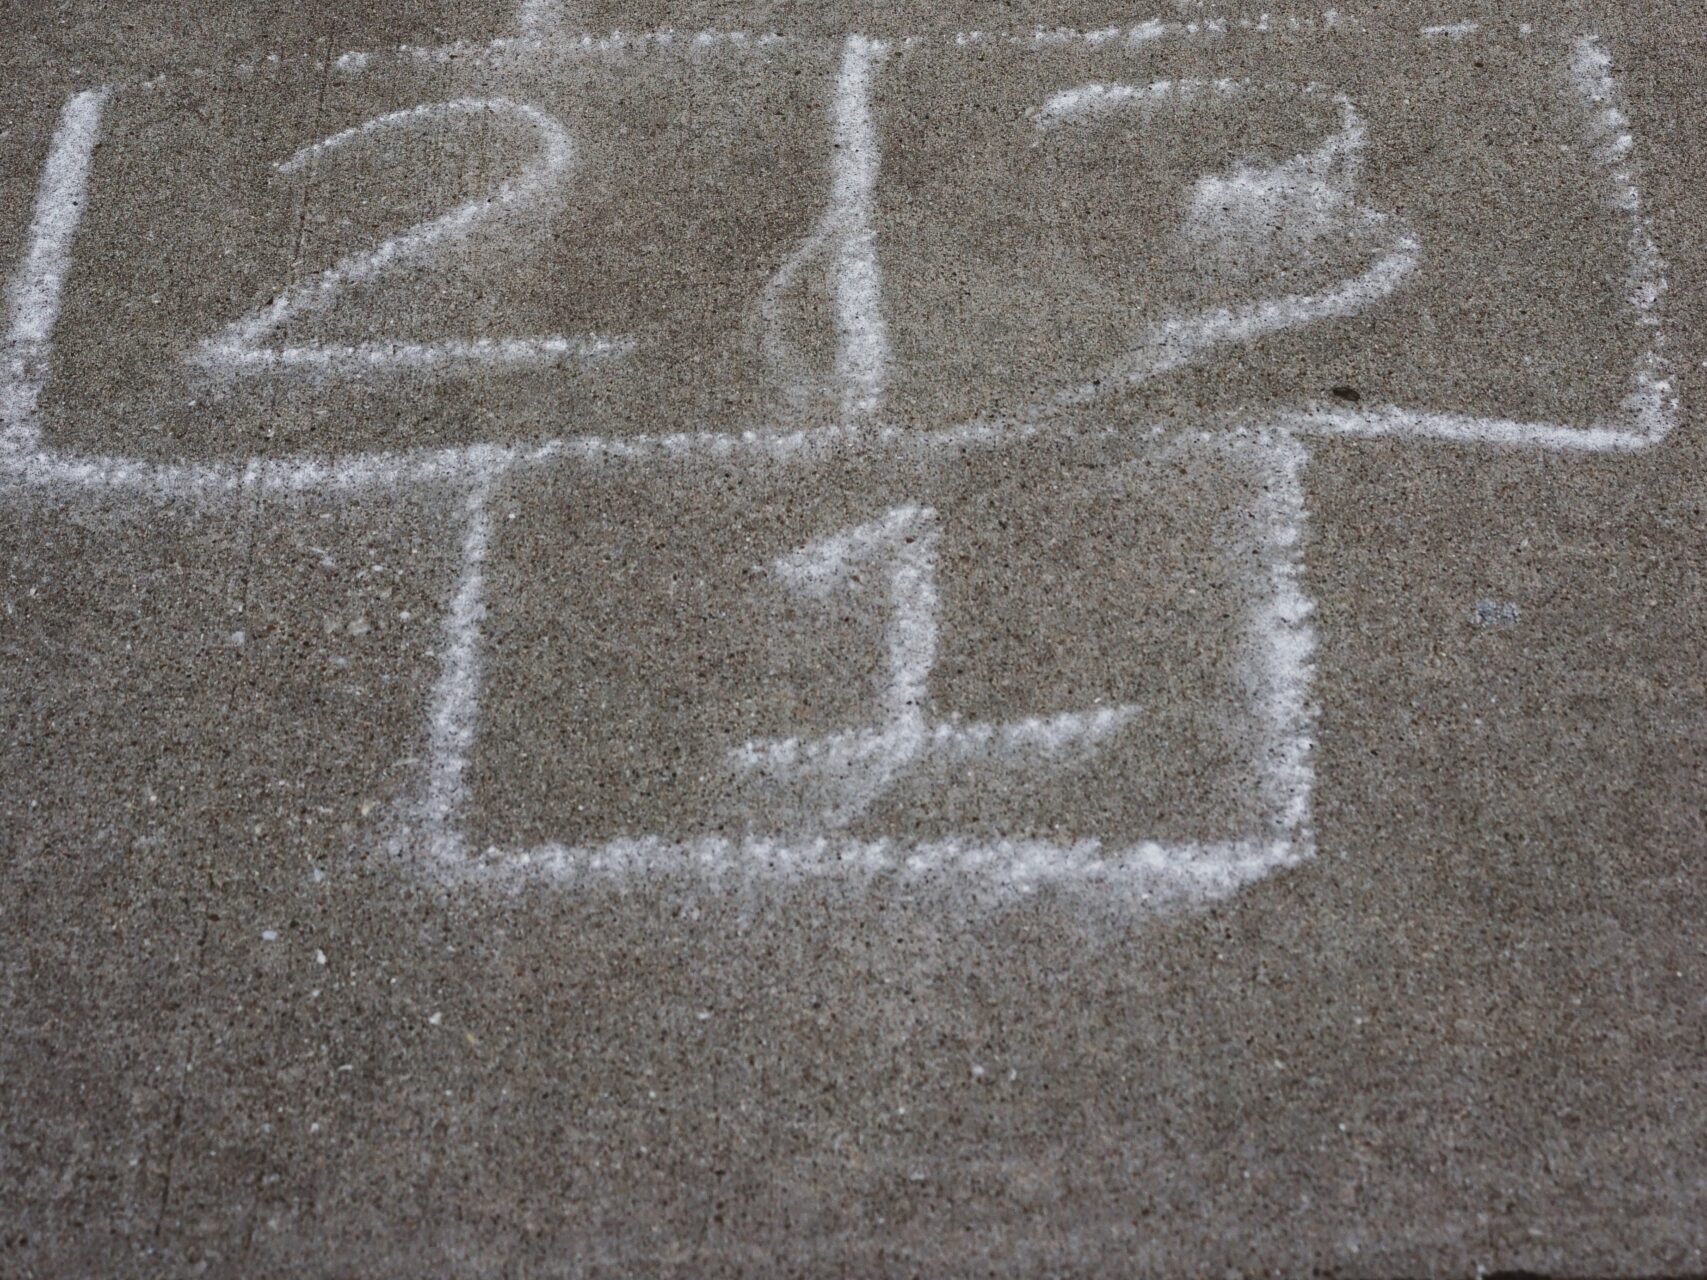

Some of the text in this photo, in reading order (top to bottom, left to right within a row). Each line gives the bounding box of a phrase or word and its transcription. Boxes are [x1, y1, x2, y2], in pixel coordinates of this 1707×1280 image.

[192, 95, 635, 372] 2
[1035, 75, 1422, 395] 3
[732, 503, 1142, 775] 1
